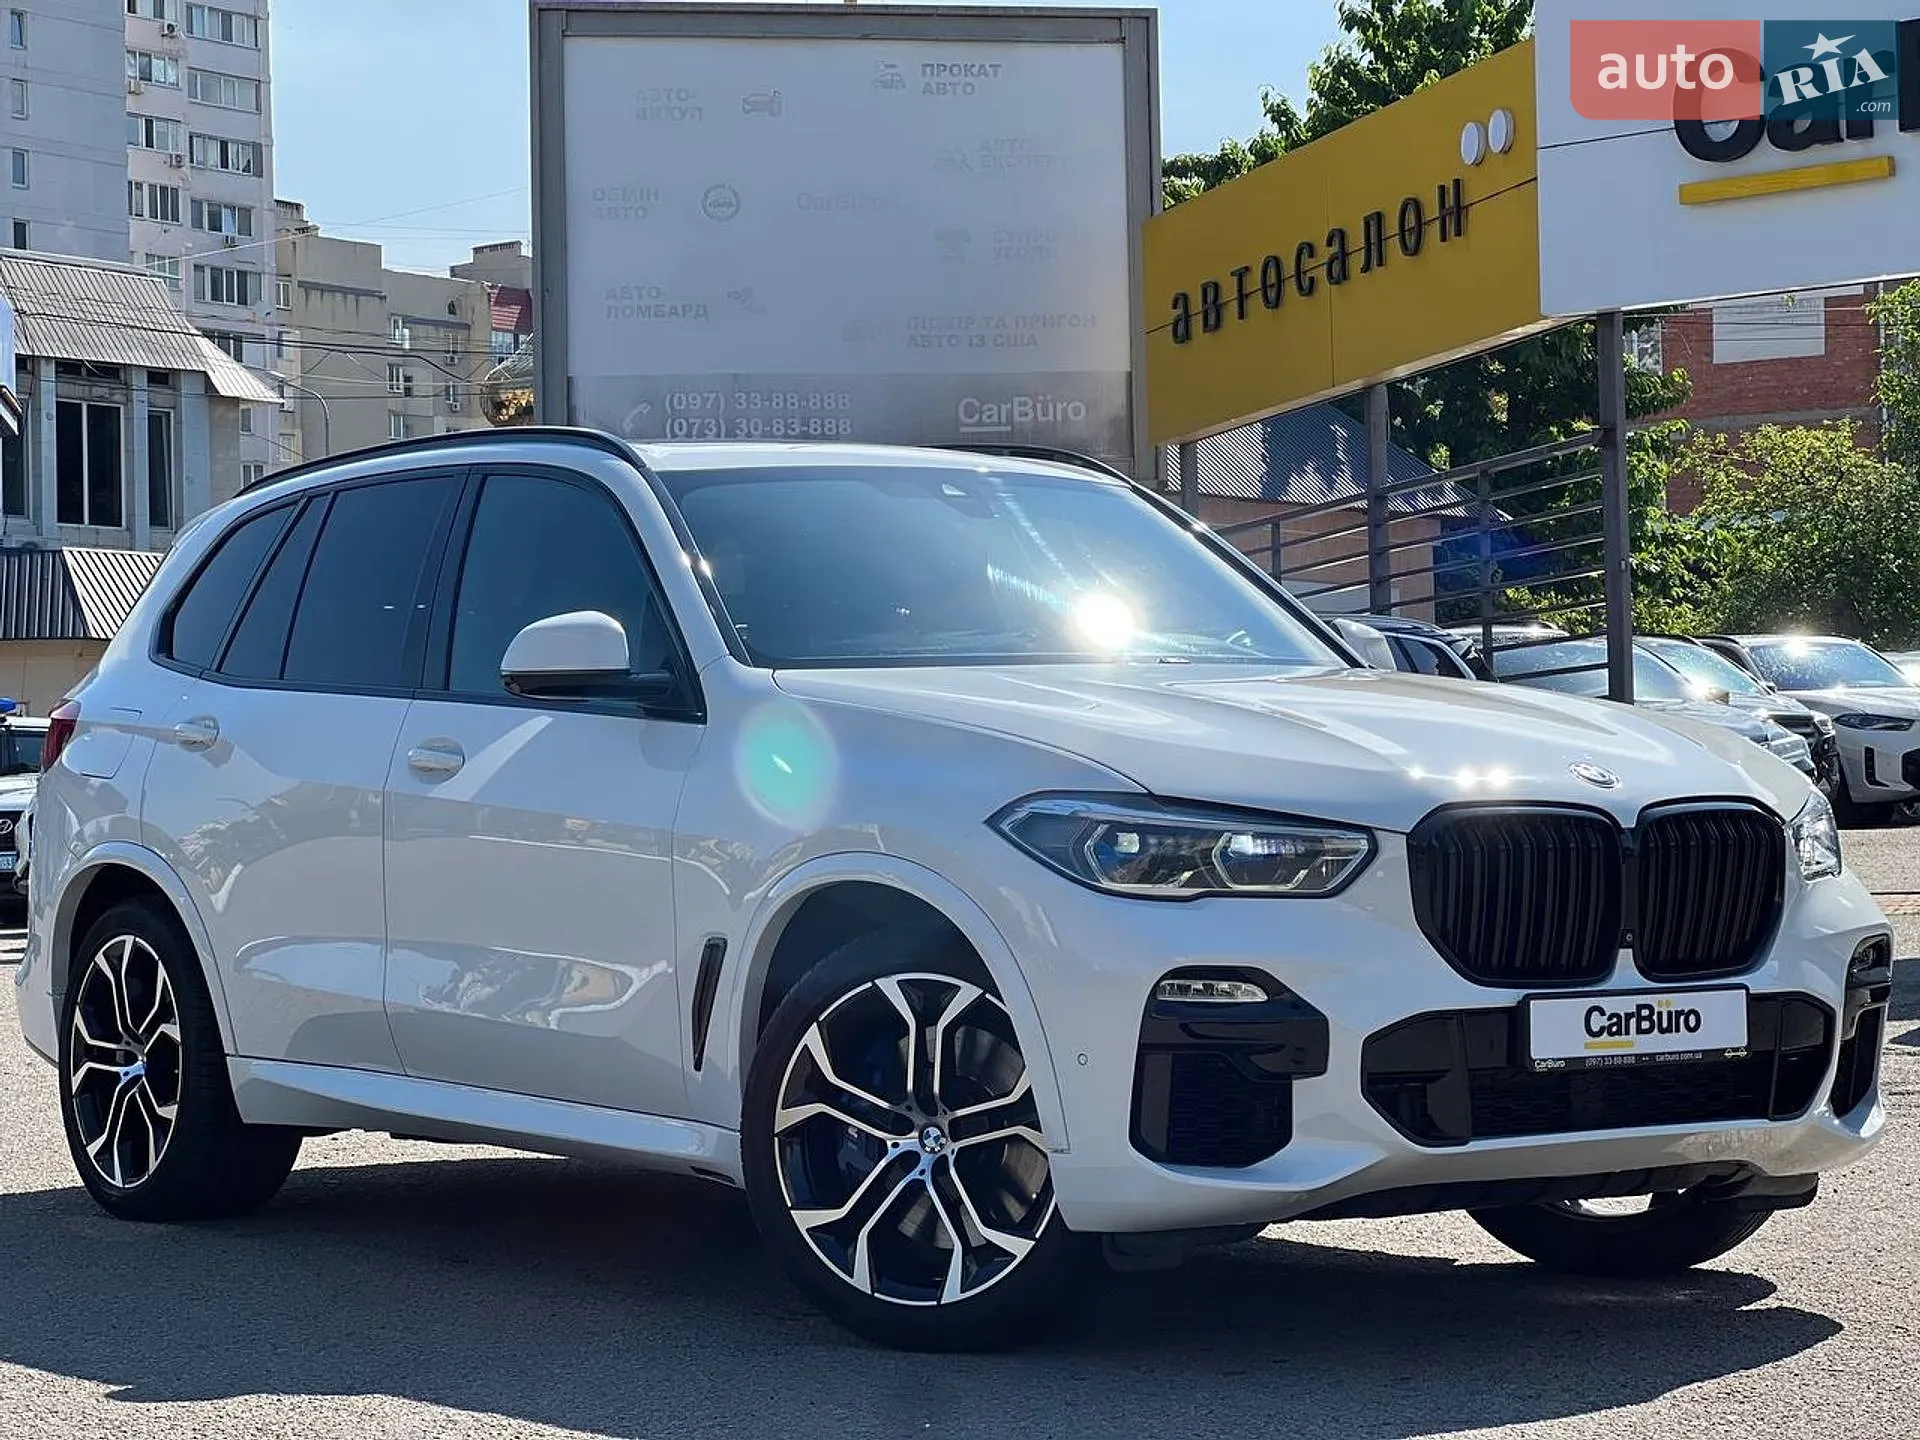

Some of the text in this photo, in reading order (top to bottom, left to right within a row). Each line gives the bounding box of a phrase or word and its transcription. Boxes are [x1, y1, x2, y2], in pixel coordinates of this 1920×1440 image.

[921, 63, 1002, 78] ПРОКАТ
[921, 81, 976, 96] АВТО
[1673, 18, 1920, 163] Car
[592, 187, 660, 203] ОБМІН
[1171, 178, 1464, 344] автосалон
[604, 285, 666, 301] АВТО-
[605, 303, 710, 323] ЛОМБАРД
[984, 315, 1009, 330] ТА
[1015, 313, 1098, 330] ПРИГОН
[906, 333, 962, 349] АВТО
[993, 333, 1039, 348] США
[665, 391, 851, 415] (097) 33-88-888
[957, 394, 1087, 424] CarBüro
[665, 417, 852, 440] (073) 30-83-888
[1583, 1000, 1702, 1038] CarBüro
